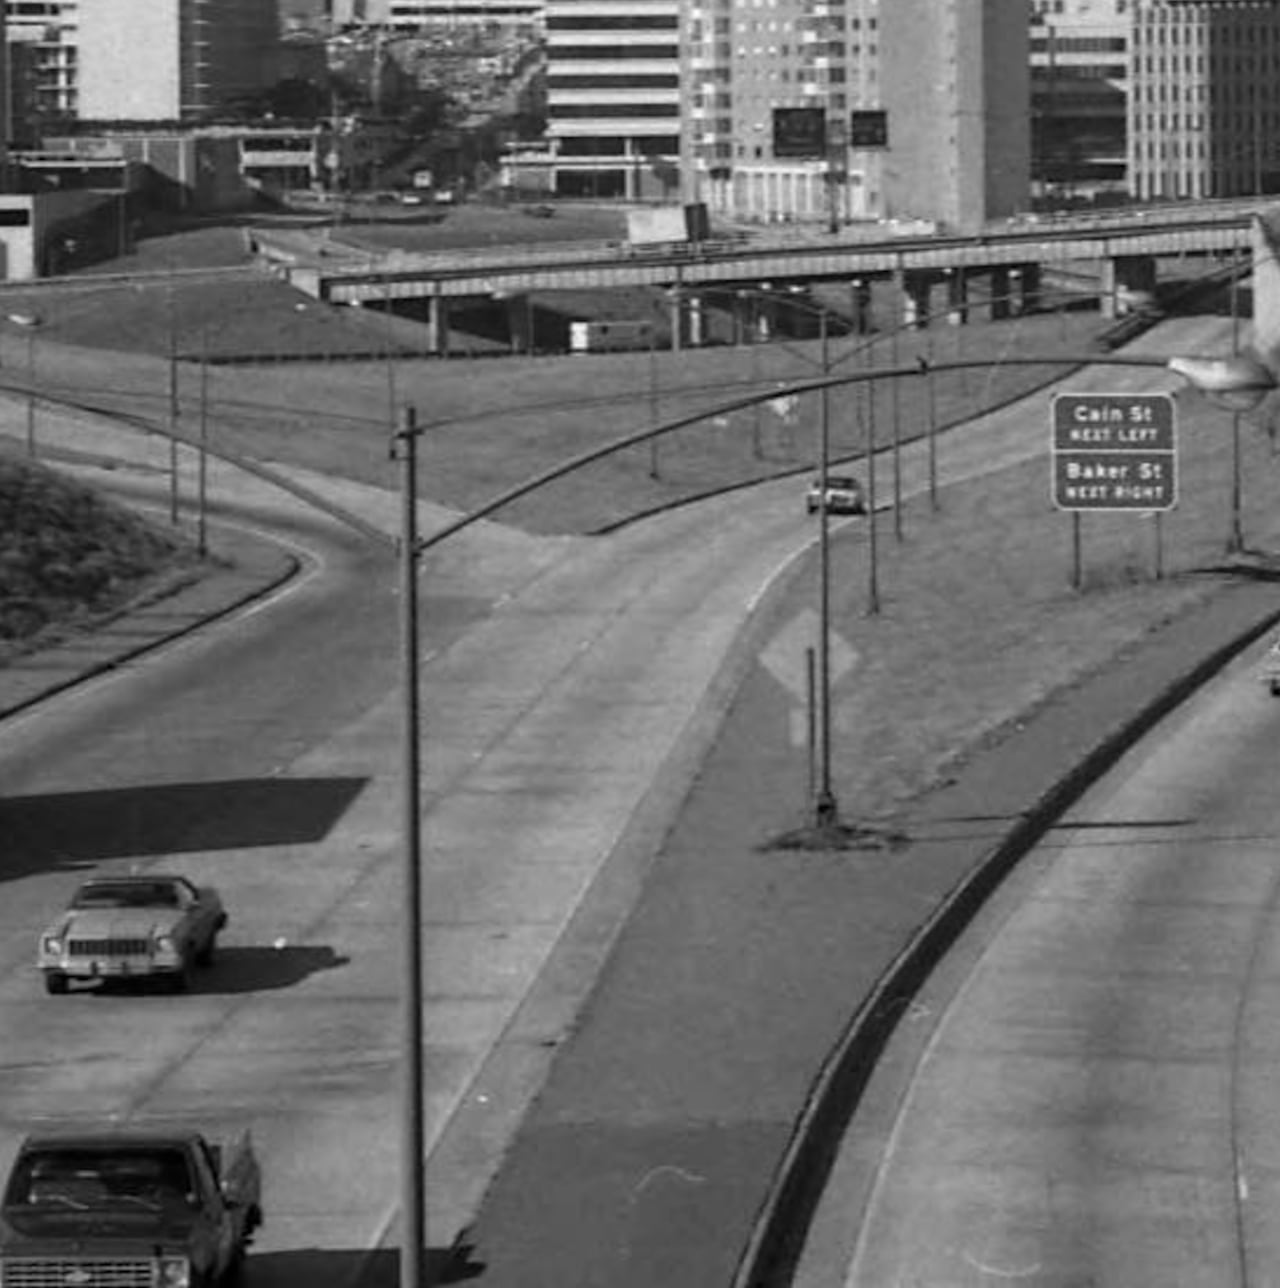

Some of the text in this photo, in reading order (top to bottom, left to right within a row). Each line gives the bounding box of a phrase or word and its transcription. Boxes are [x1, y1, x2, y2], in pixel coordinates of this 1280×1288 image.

[1073, 404, 1153, 423] Cain St
[1069, 427, 1158, 442] NEXT LEFT
[1066, 462, 1163, 480] Baker St
[1065, 485, 1164, 500] NEXT RIGHT
